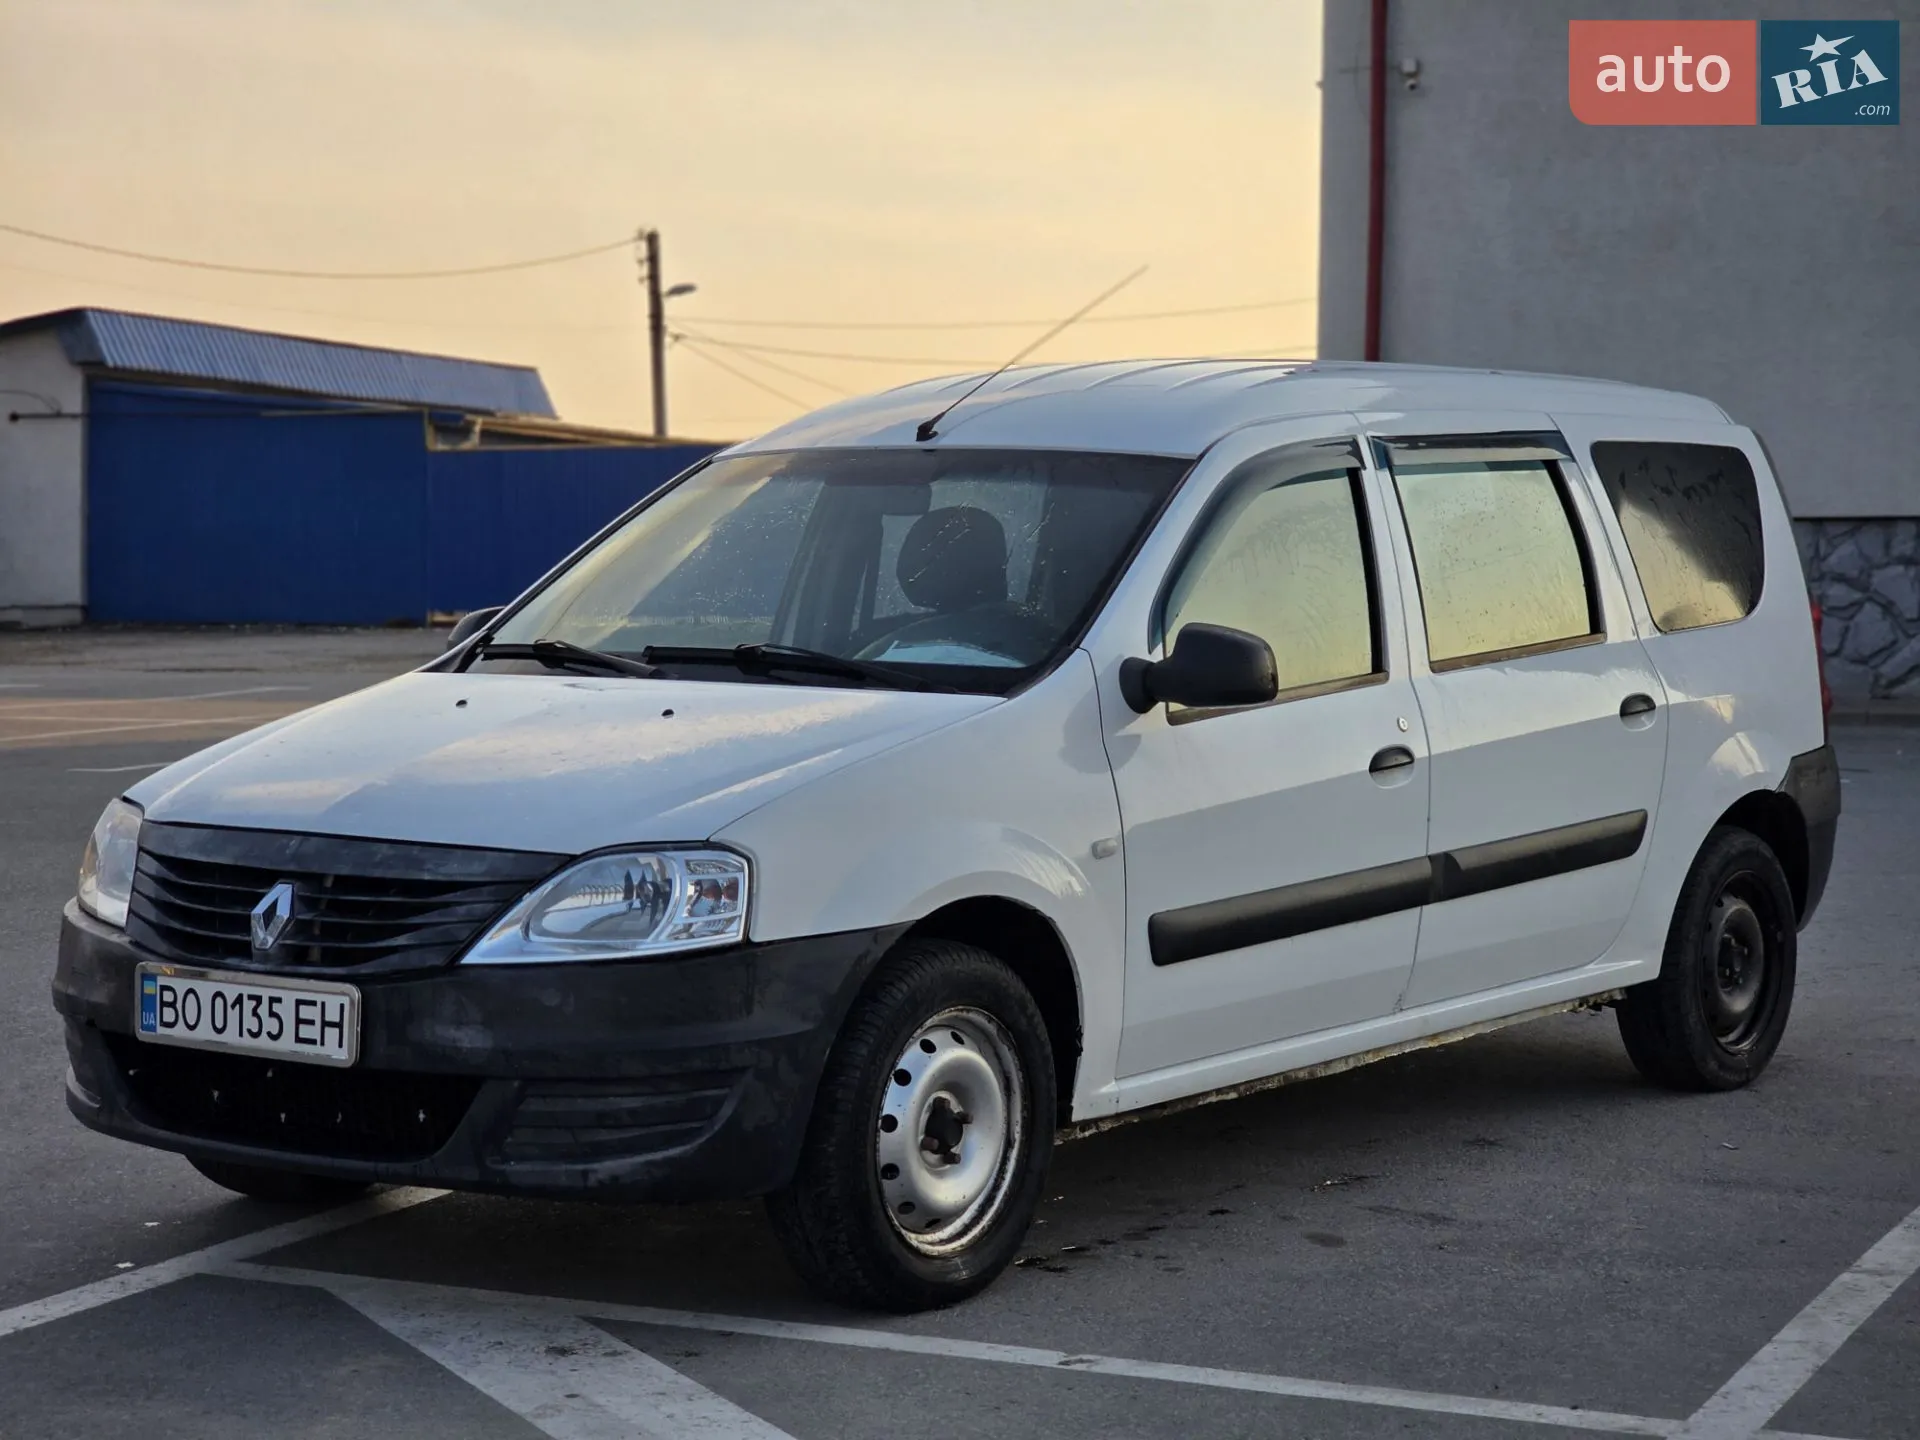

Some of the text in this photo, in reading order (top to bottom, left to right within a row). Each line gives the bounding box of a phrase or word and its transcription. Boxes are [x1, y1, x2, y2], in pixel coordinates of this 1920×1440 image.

[143, 1011, 156, 1026] UA
[159, 984, 345, 1049] BO 0135 EH
